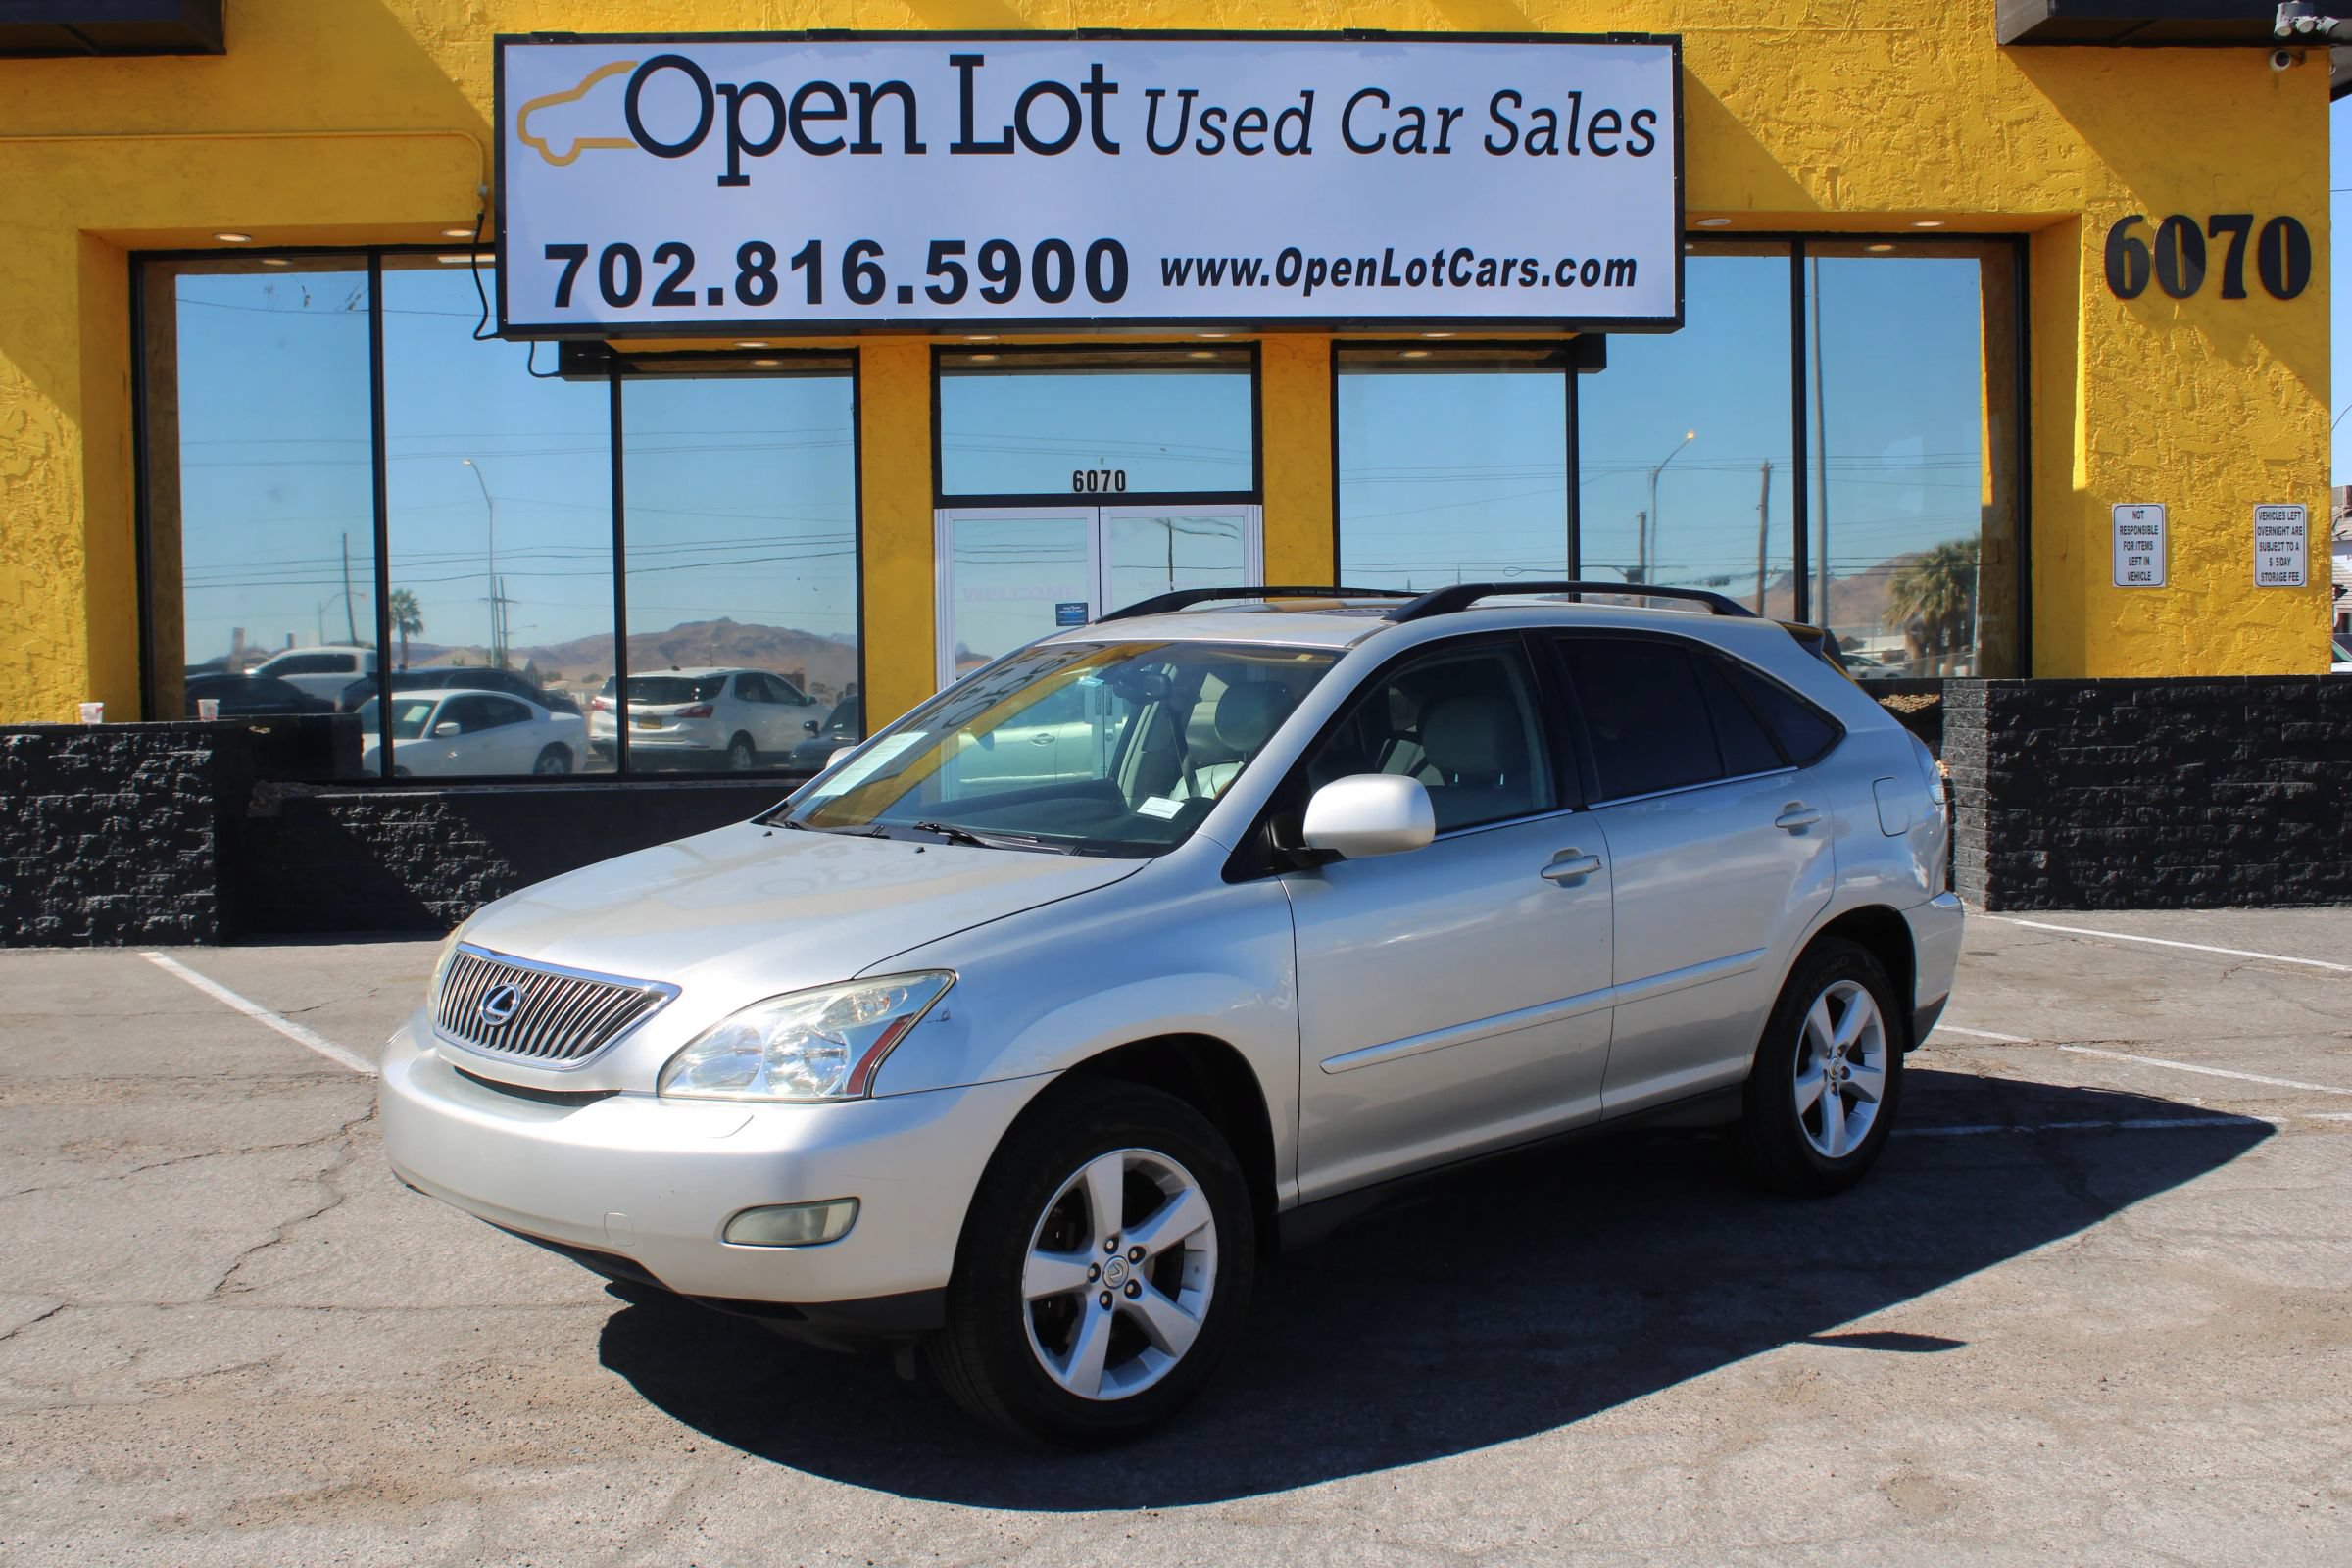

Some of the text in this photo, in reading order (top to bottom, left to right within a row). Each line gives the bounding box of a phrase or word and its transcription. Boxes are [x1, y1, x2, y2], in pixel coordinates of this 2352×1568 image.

[624, 54, 1656, 186] Open Lot Used Car Sales
[2104, 214, 2312, 300] 6070
[545, 238, 1637, 308] 702.816.5900 www.OpenLotCars.com
[1072, 469, 1126, 493] 6070
[2132, 510, 2145, 520] NOT
[2258, 511, 2302, 521] VEHICLES LEFT
[2119, 525, 2159, 536] RESPONSIBLE
[2257, 526, 2303, 536] OVERNIGHT ARE
[2123, 540, 2154, 551] FOR ITEMS
[2259, 541, 2284, 552] SUBJECT
[2286, 541, 2294, 552] TO
[2128, 556, 2150, 566] LEFT IN
[2127, 571, 2152, 581] VEHICLE
[2260, 572, 2300, 582] STORAGE FEE
